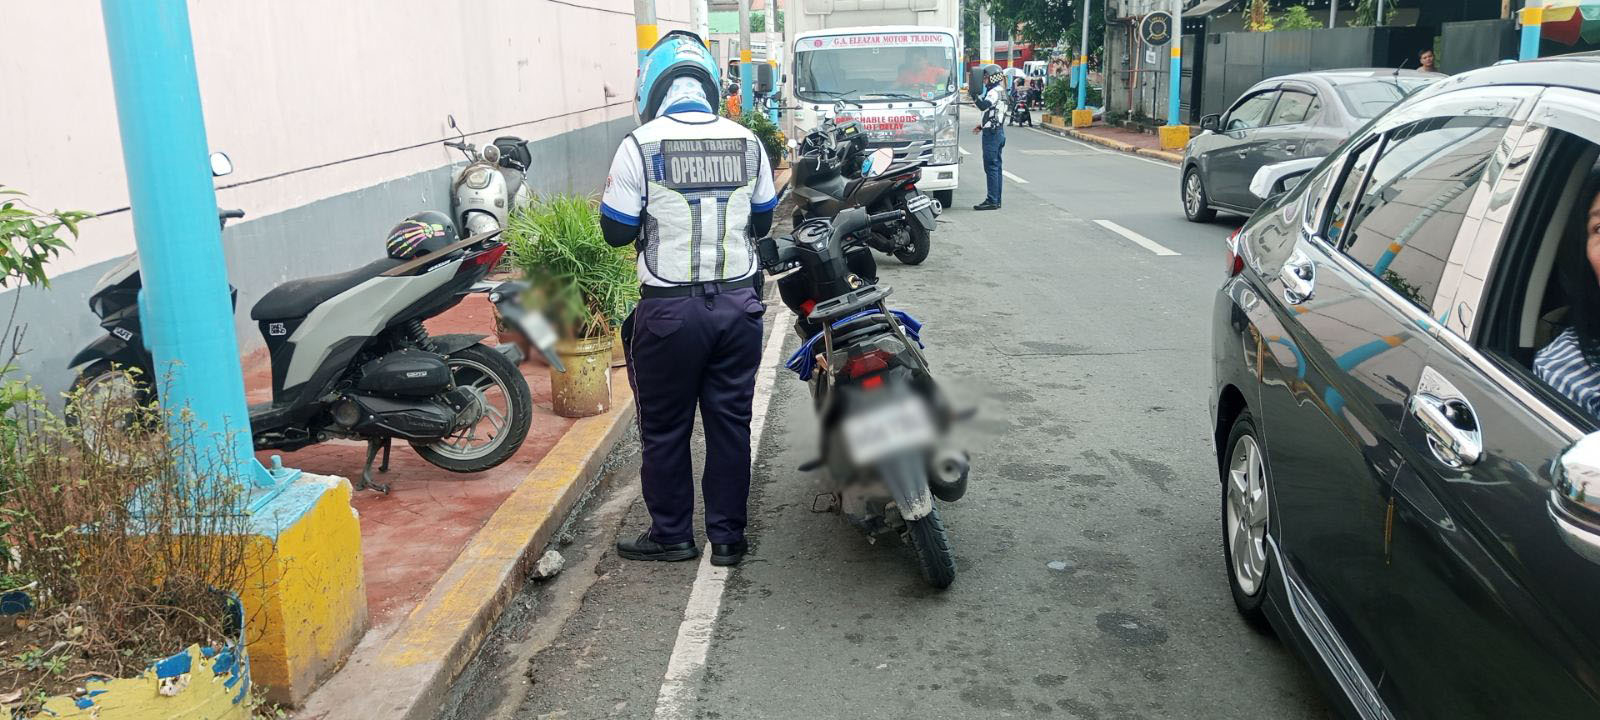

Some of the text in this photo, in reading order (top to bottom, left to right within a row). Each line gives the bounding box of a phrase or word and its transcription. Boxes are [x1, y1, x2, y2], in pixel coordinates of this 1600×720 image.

[849, 36, 880, 45] ELEAZAR
[882, 35, 908, 43] MOTOR
[888, 115, 917, 123] GOODS
[664, 139, 742, 153] MANILA TRAFFIC
[671, 155, 742, 184] OPERATION
